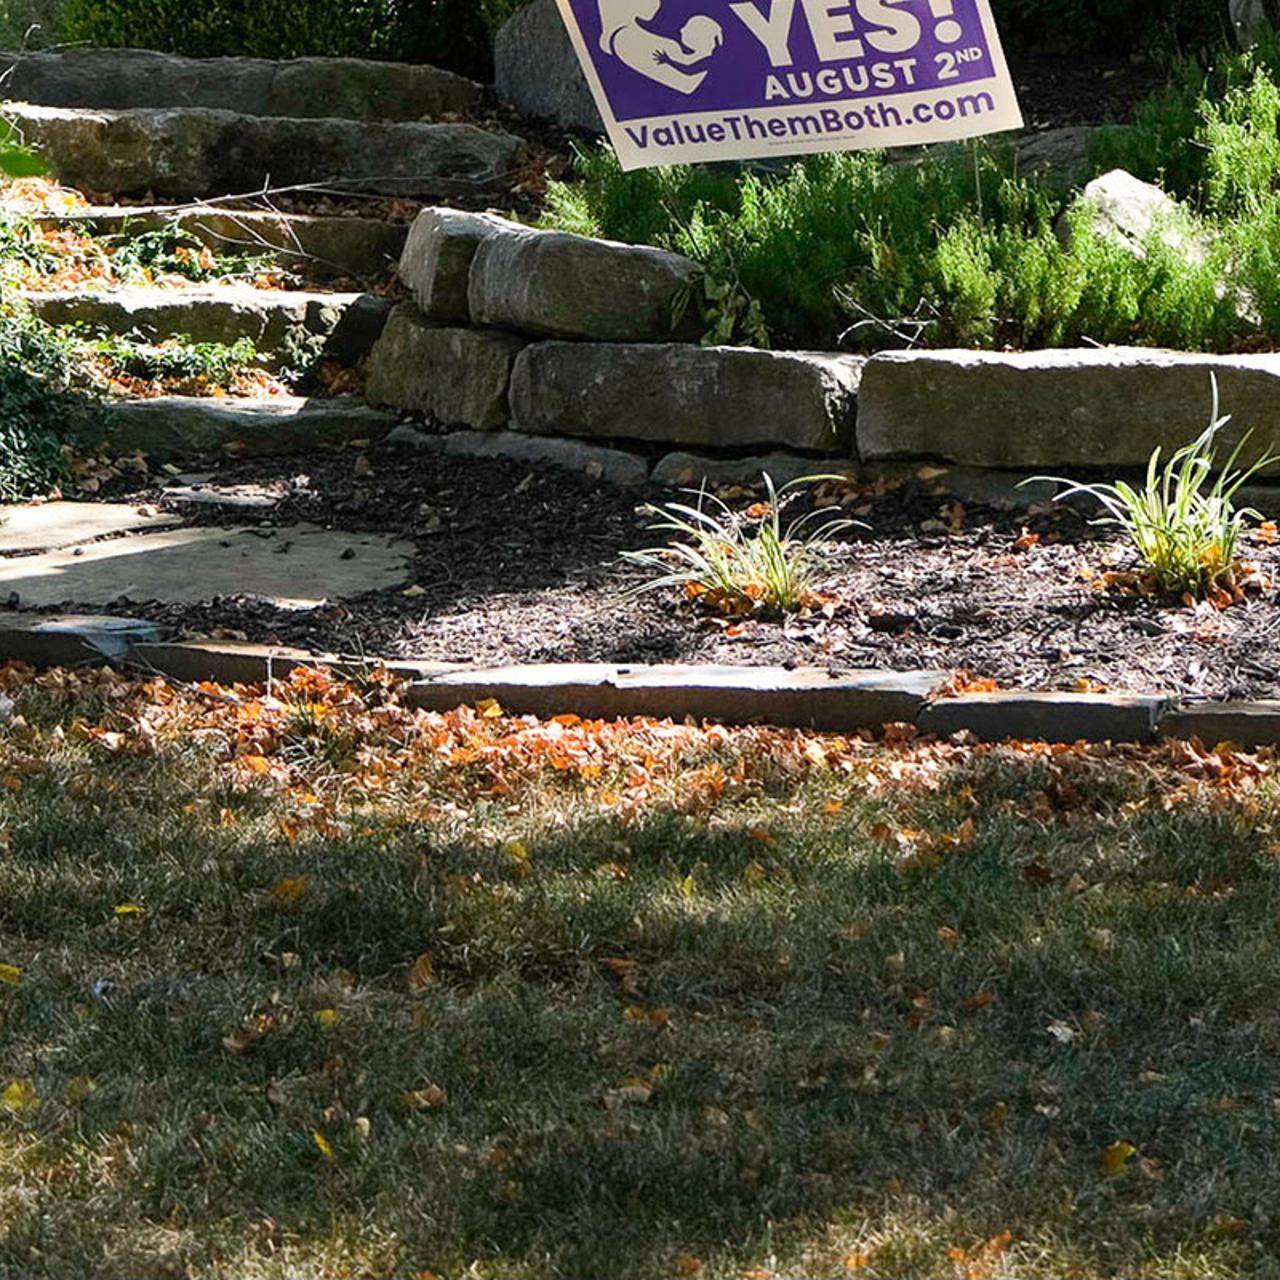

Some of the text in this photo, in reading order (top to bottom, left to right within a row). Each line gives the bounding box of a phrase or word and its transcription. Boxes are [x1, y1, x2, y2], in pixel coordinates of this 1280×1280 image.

[764, 47, 983, 101] AUGUST 2ND
[625, 89, 995, 150] ValueThemBoth.com
